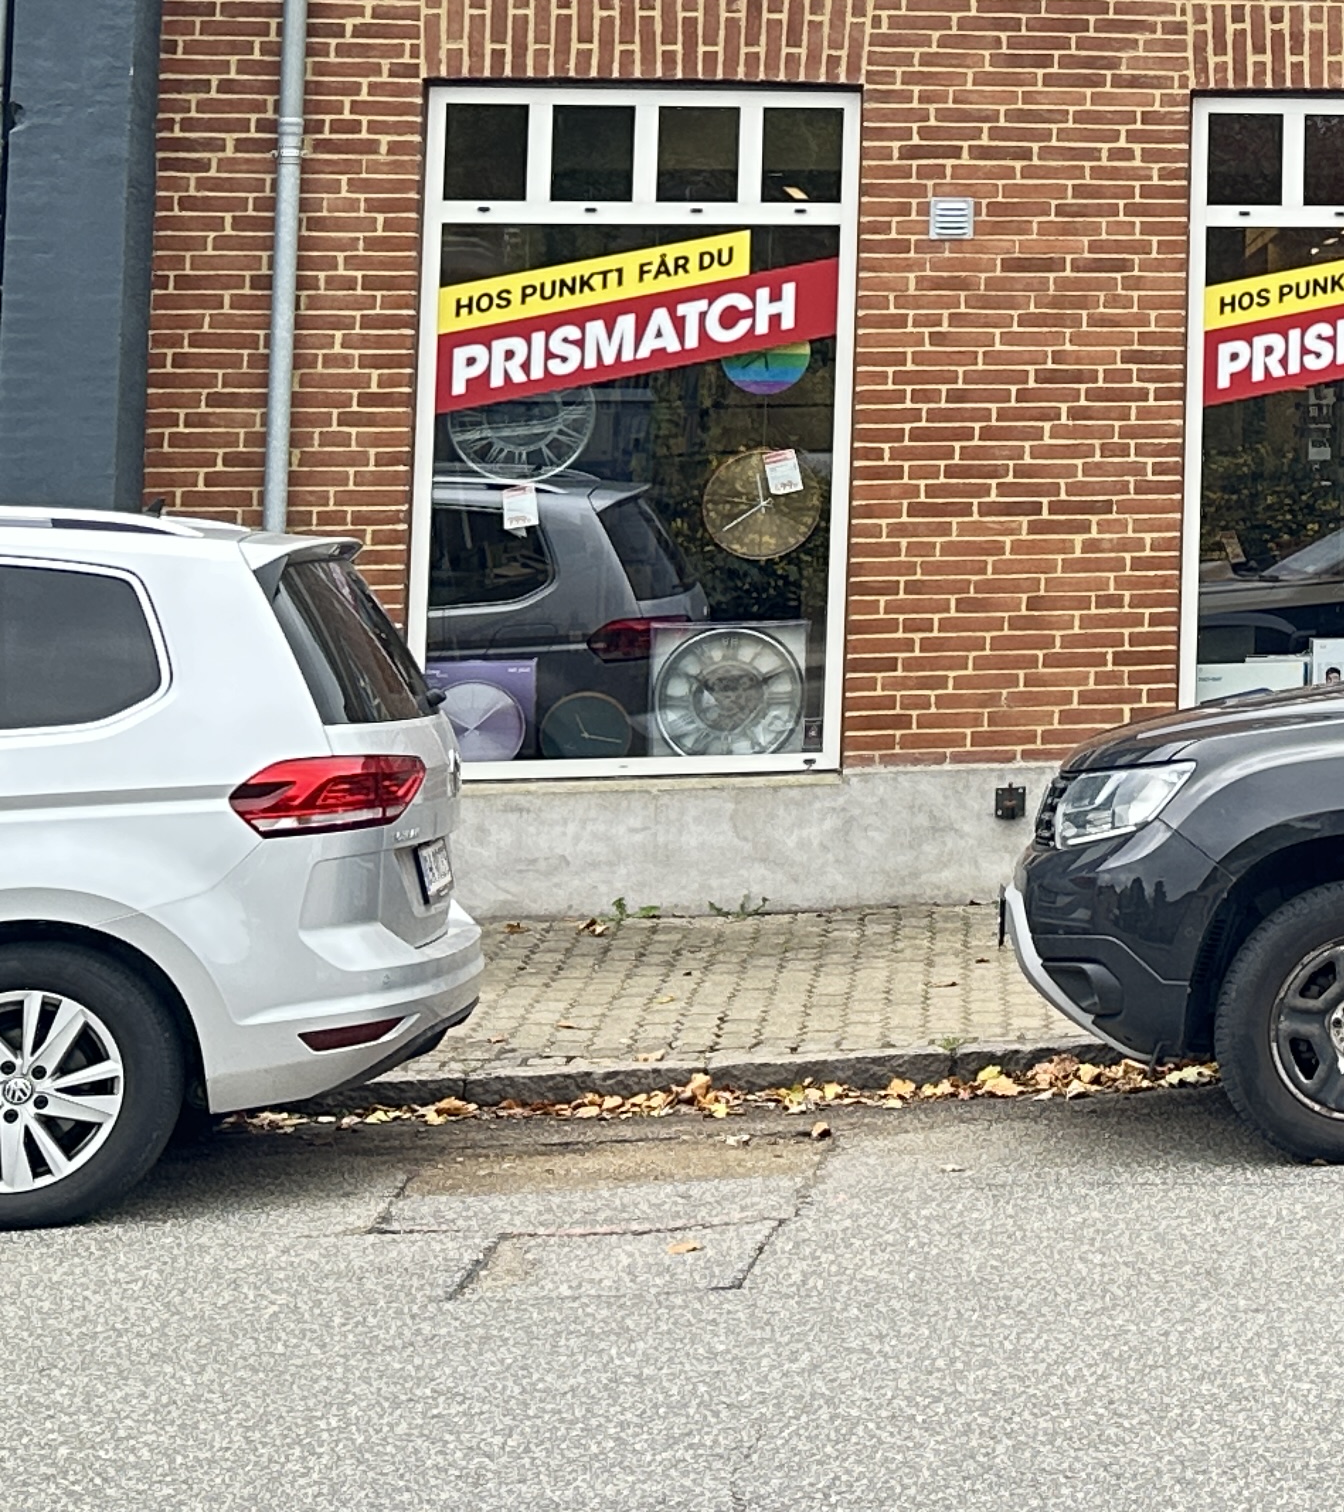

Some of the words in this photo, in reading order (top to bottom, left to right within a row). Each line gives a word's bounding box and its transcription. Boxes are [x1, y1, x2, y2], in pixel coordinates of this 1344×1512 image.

[455, 288, 512, 319] HOS
[520, 267, 625, 306] PUNKT1
[638, 253, 691, 284] FÅR
[698, 246, 735, 273] DU
[1219, 288, 1272, 316] HOS
[450, 281, 797, 397] PRISMATCH
